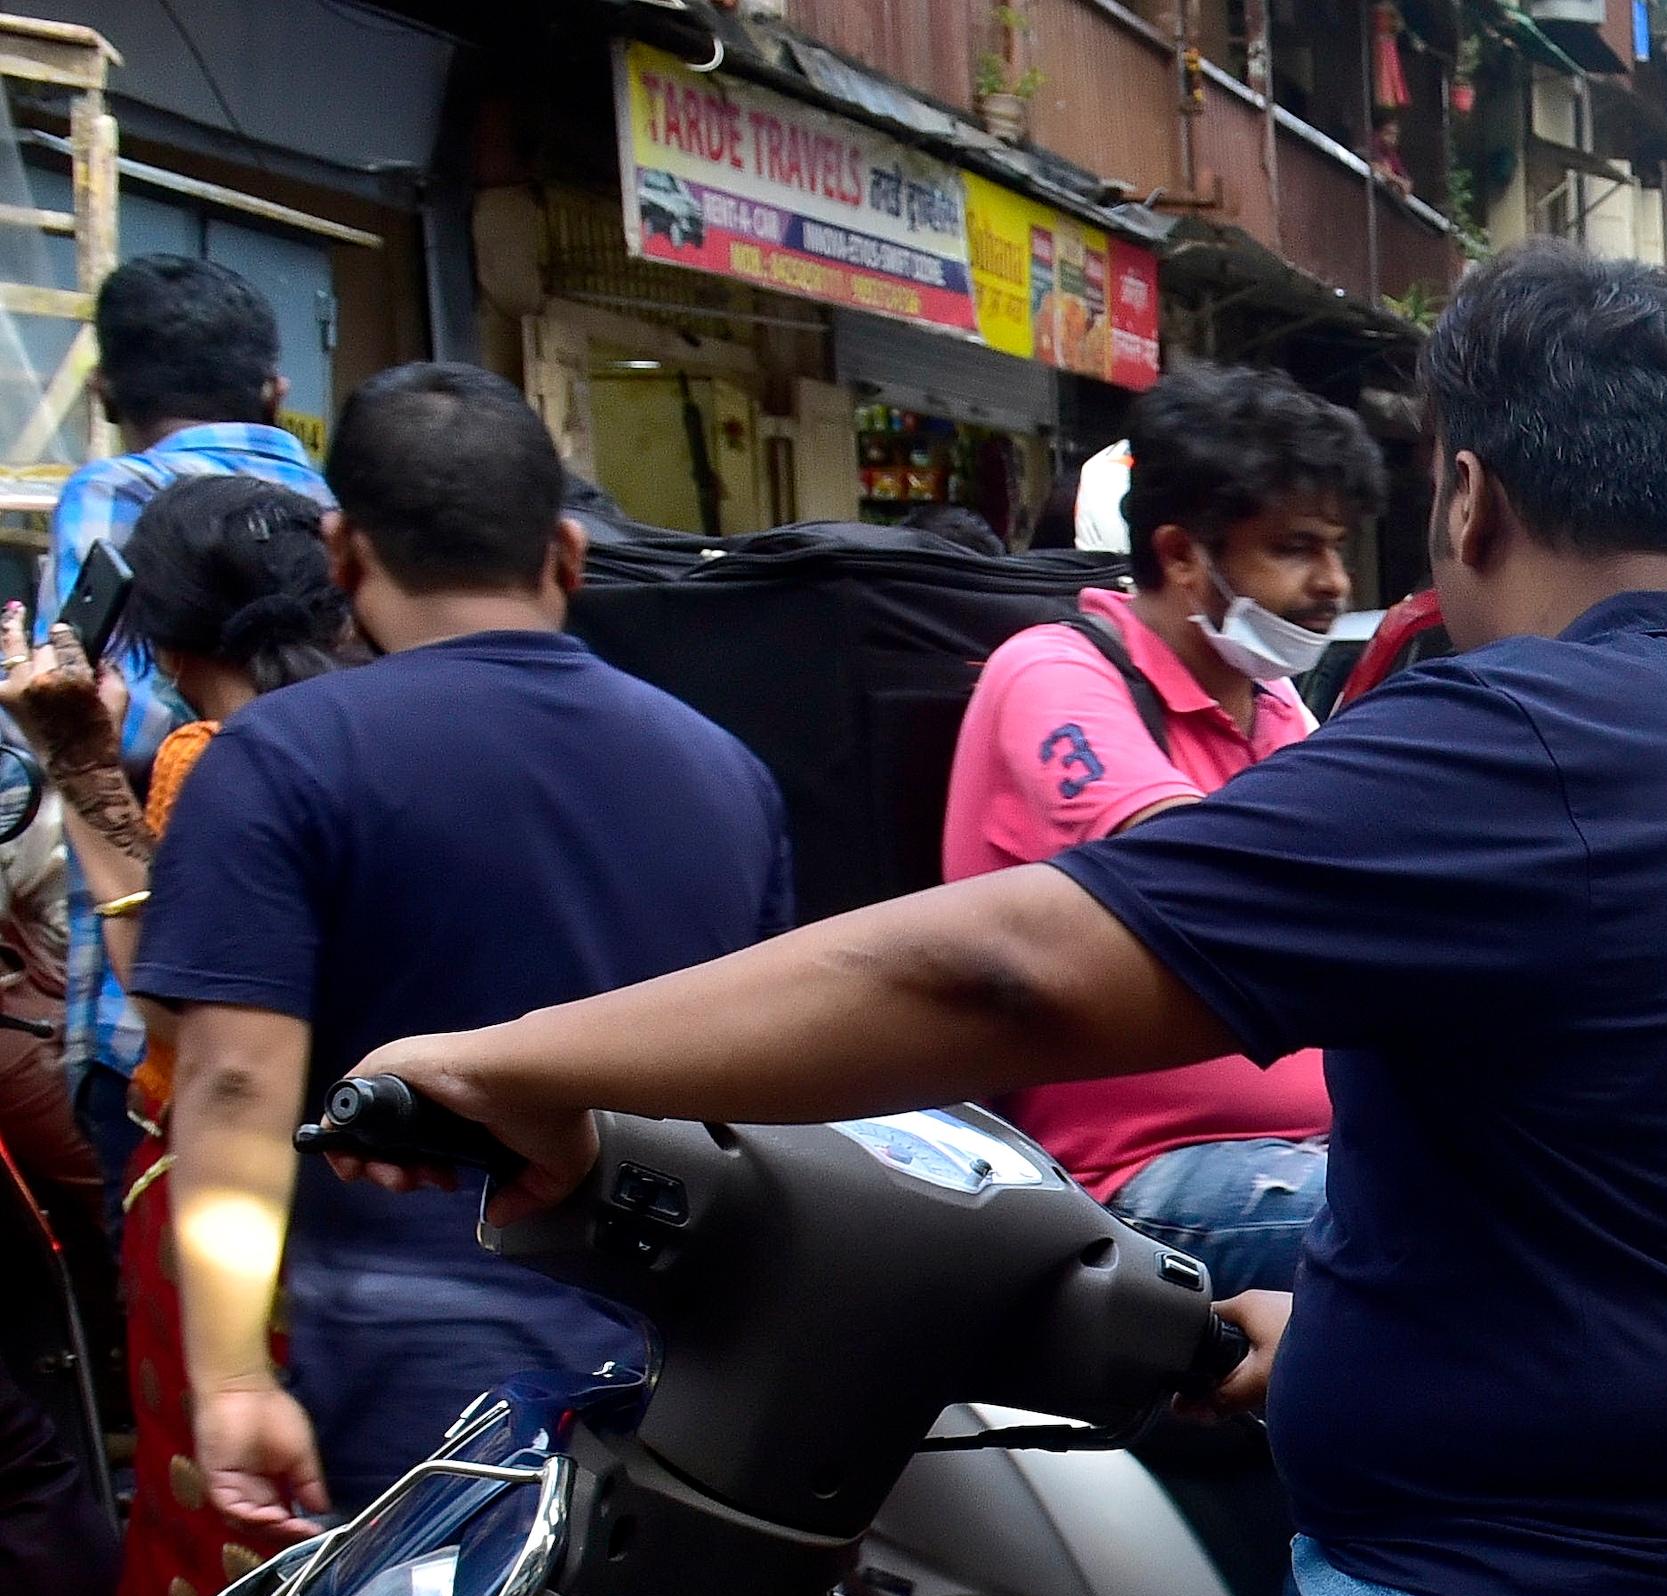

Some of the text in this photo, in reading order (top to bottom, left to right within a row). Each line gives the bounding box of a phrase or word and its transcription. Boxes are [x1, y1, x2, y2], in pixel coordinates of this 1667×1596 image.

[641, 70, 863, 206] TARDE TRAVELS
[1040, 723, 1105, 799] 3
